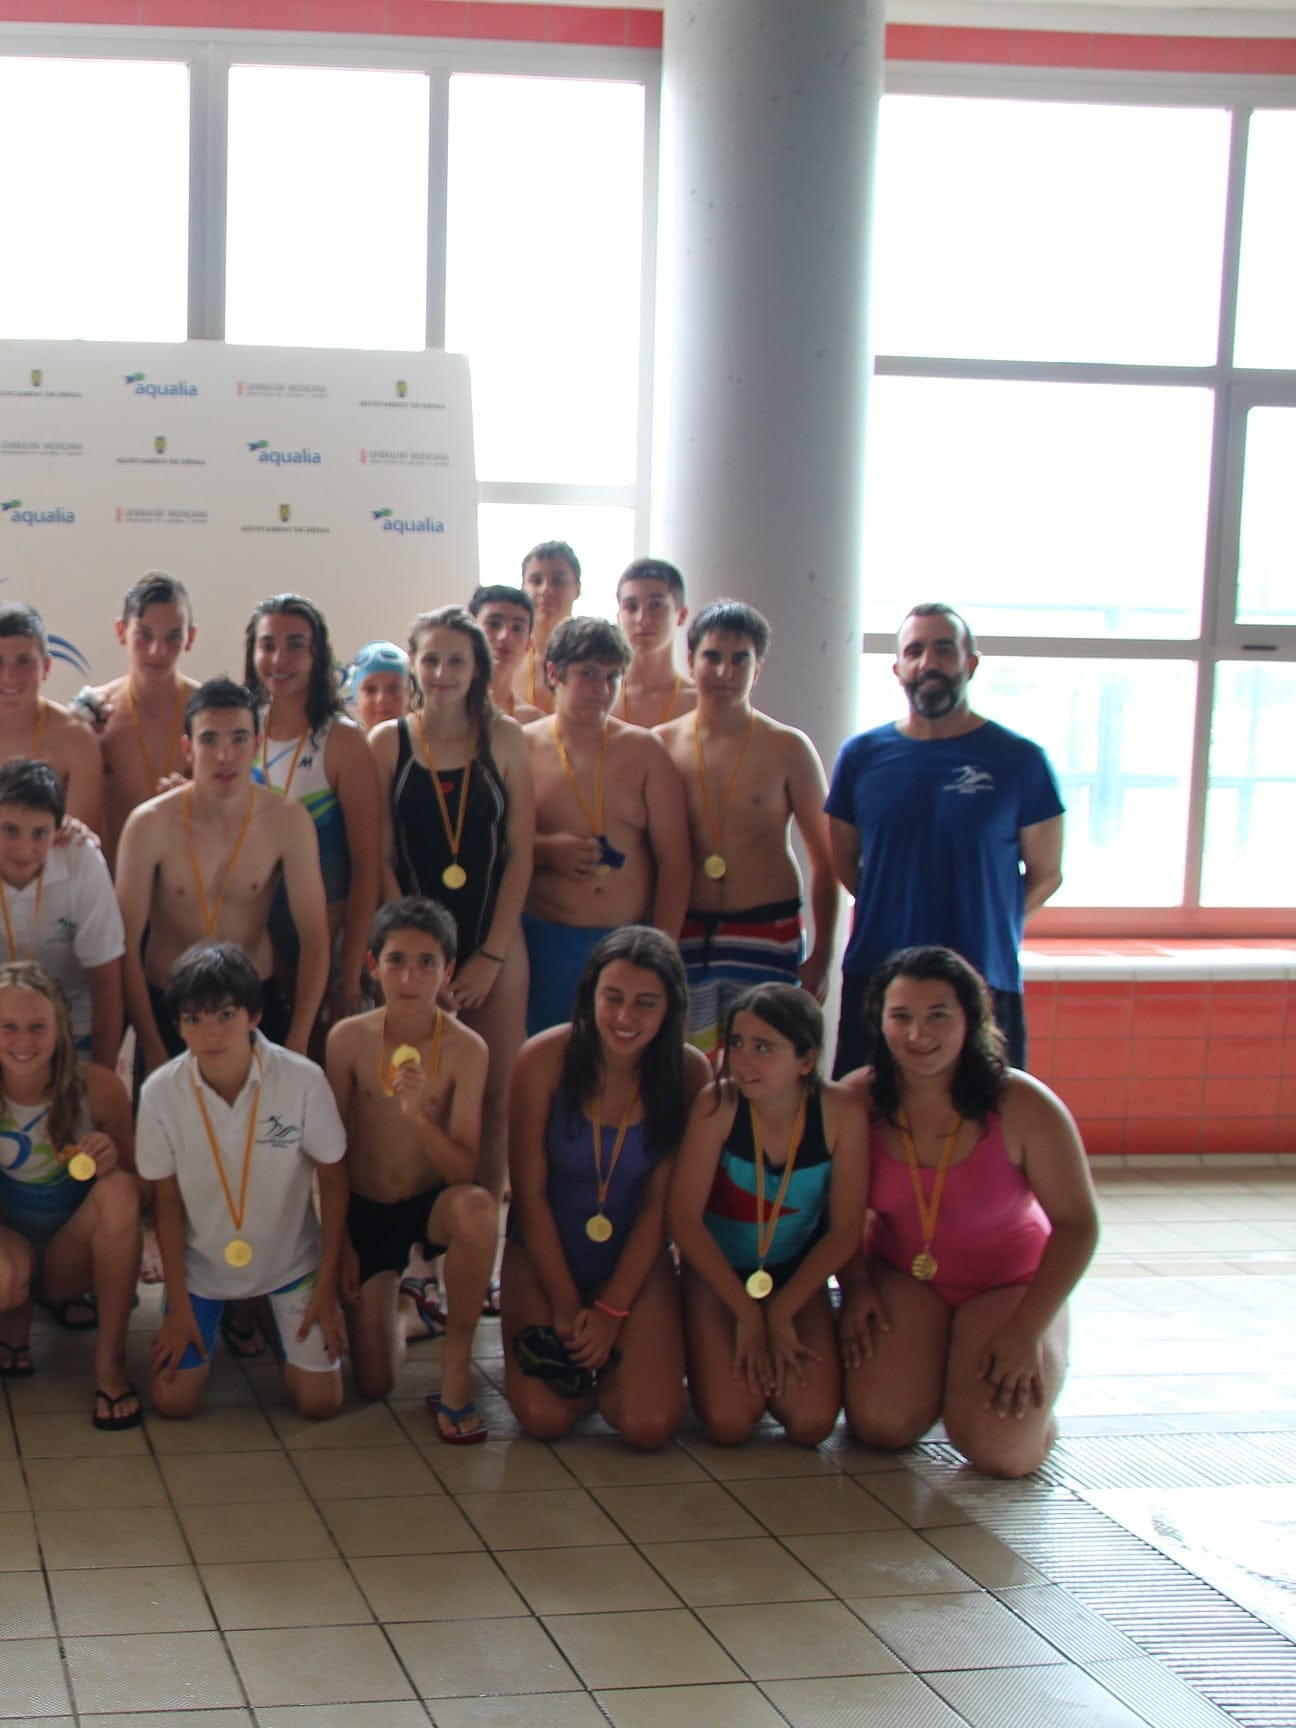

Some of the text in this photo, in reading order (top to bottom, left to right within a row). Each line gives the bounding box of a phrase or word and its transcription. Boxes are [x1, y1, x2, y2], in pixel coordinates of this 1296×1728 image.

[134, 380, 198, 399] aqualia
[258, 447, 321, 467] aqualia
[11, 507, 75, 527] aqualia
[382, 516, 445, 536] aqualia
